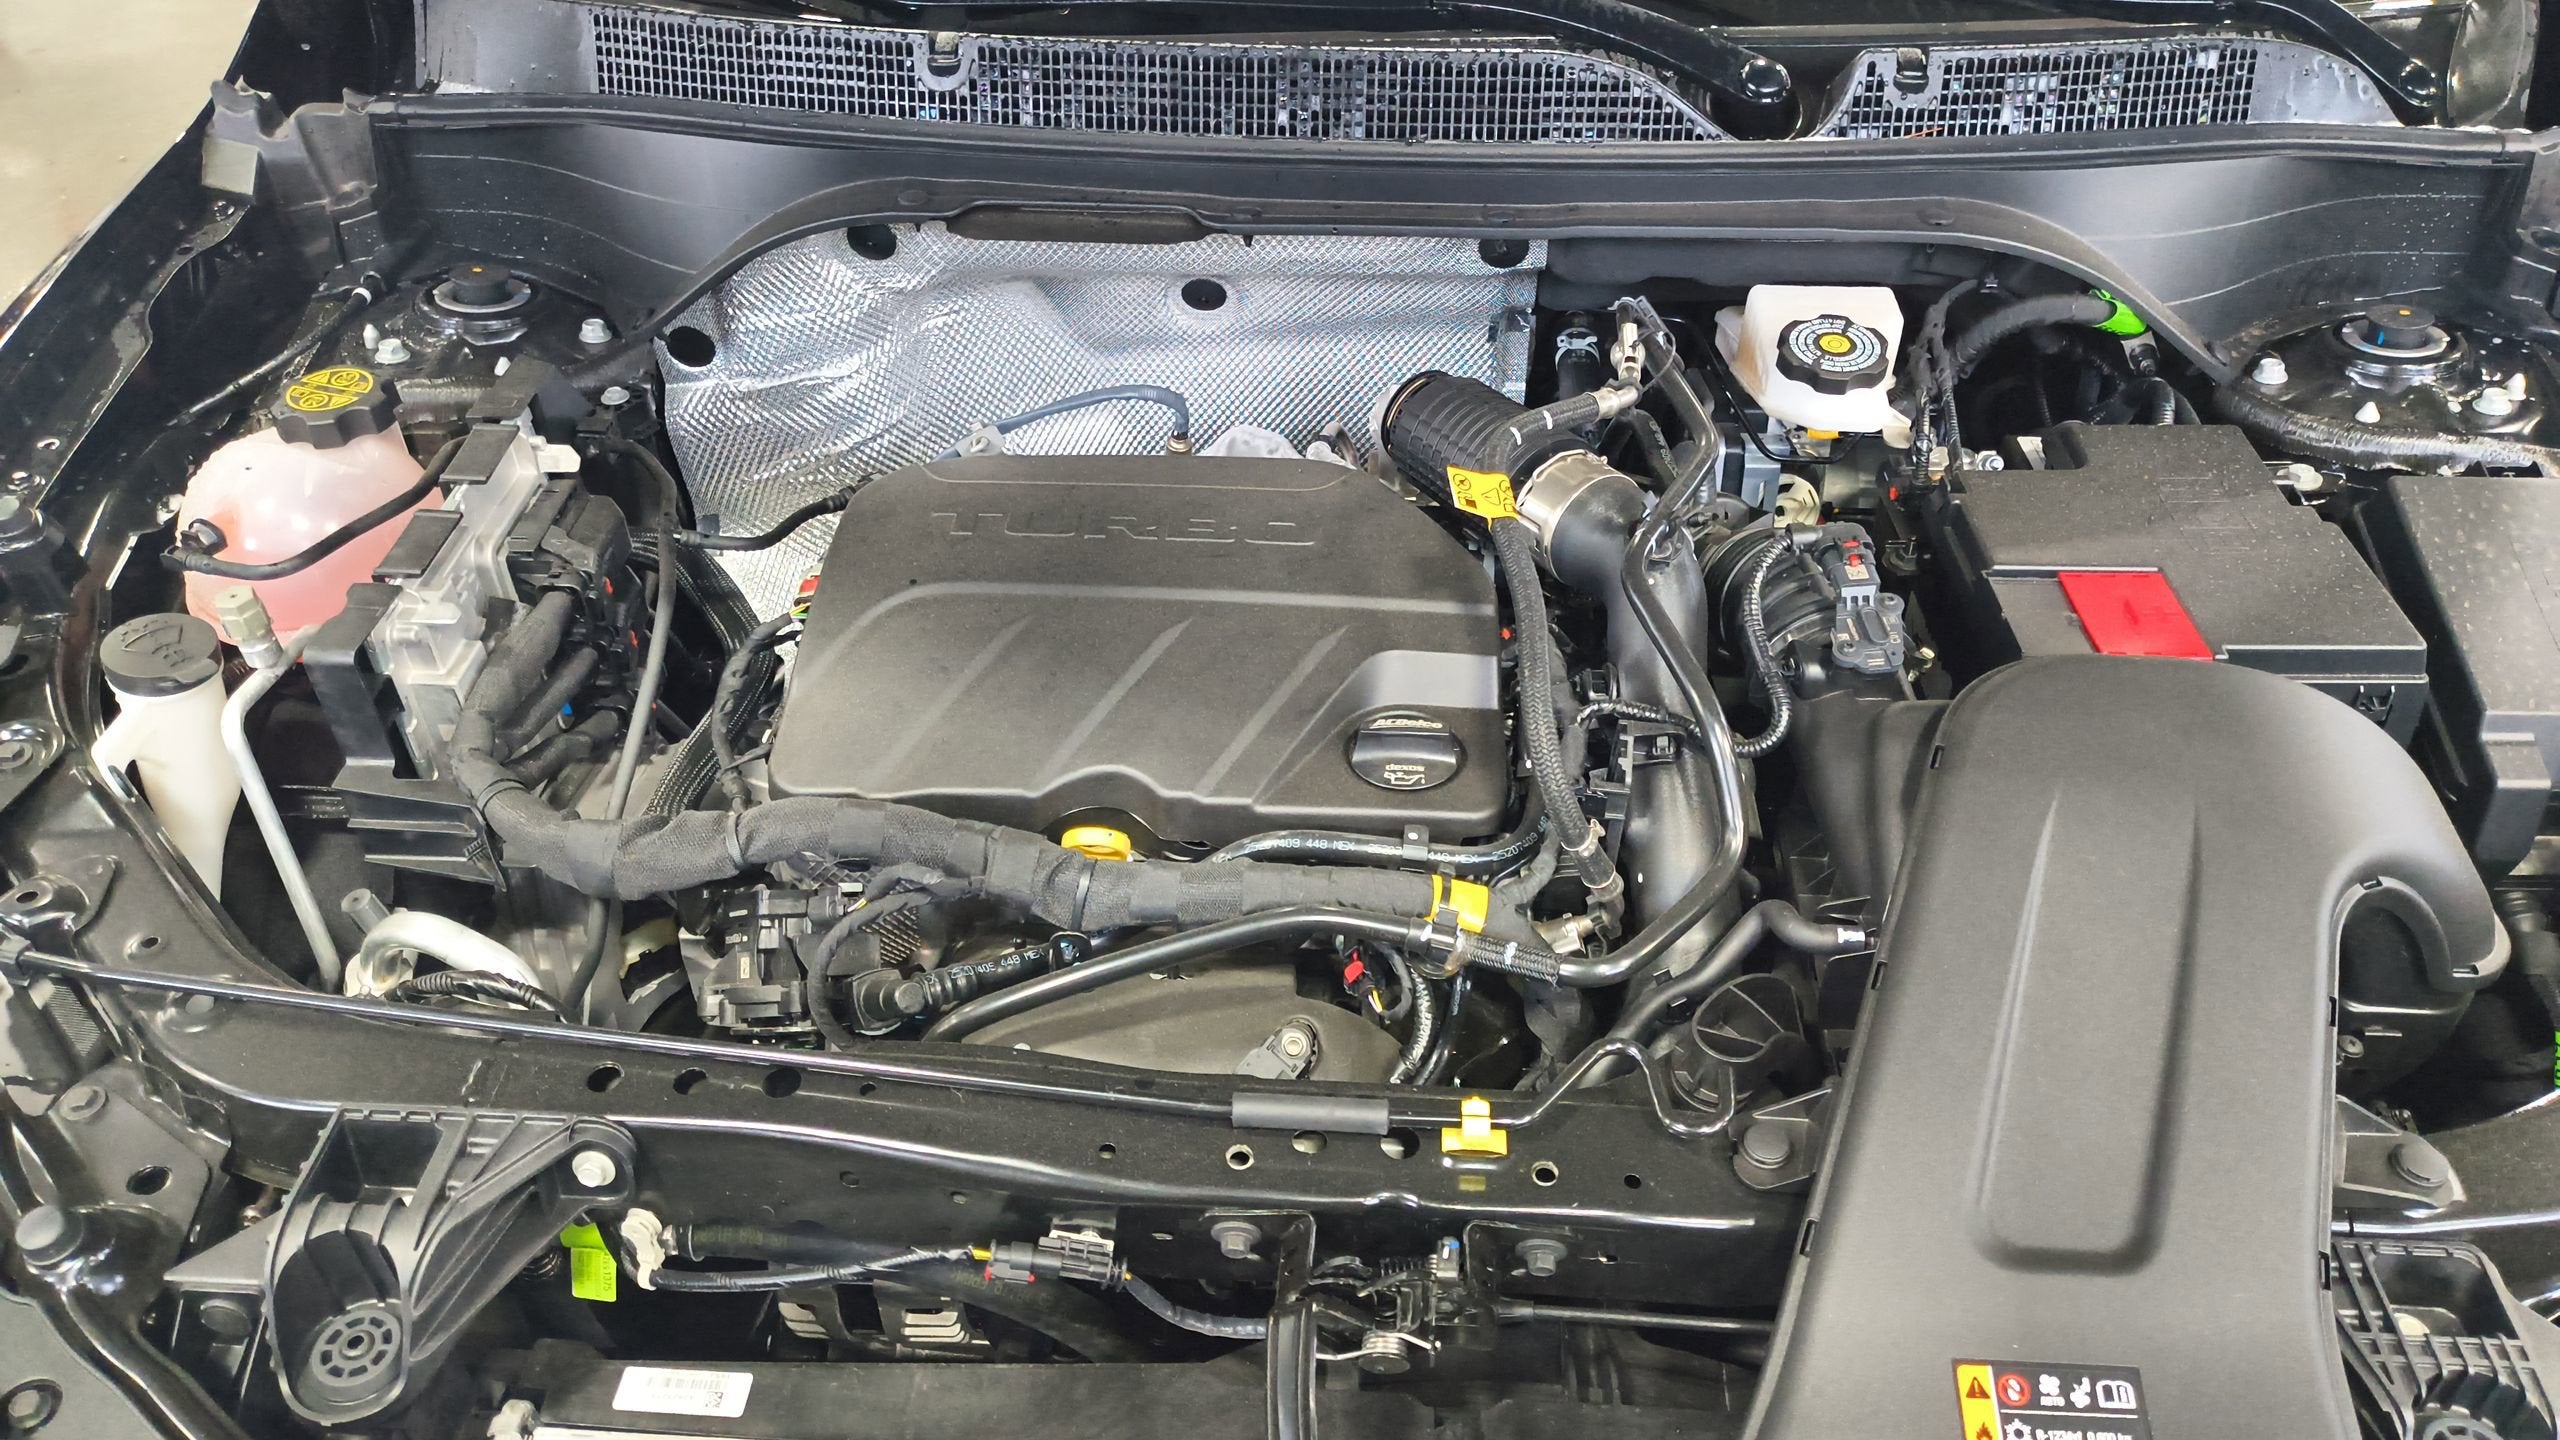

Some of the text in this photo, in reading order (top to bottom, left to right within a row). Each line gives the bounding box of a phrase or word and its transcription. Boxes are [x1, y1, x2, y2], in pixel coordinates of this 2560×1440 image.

[930, 511, 1316, 547] TURBO
[1369, 718, 1443, 729] ACDelco
[1385, 763, 1425, 772] dexos
[1305, 838, 1328, 849] 448
[1332, 839, 1355, 851] MEX
[1491, 832, 1539, 862] 25207409
[1000, 955, 1021, 968] 448
[1023, 949, 1045, 960] MEX
